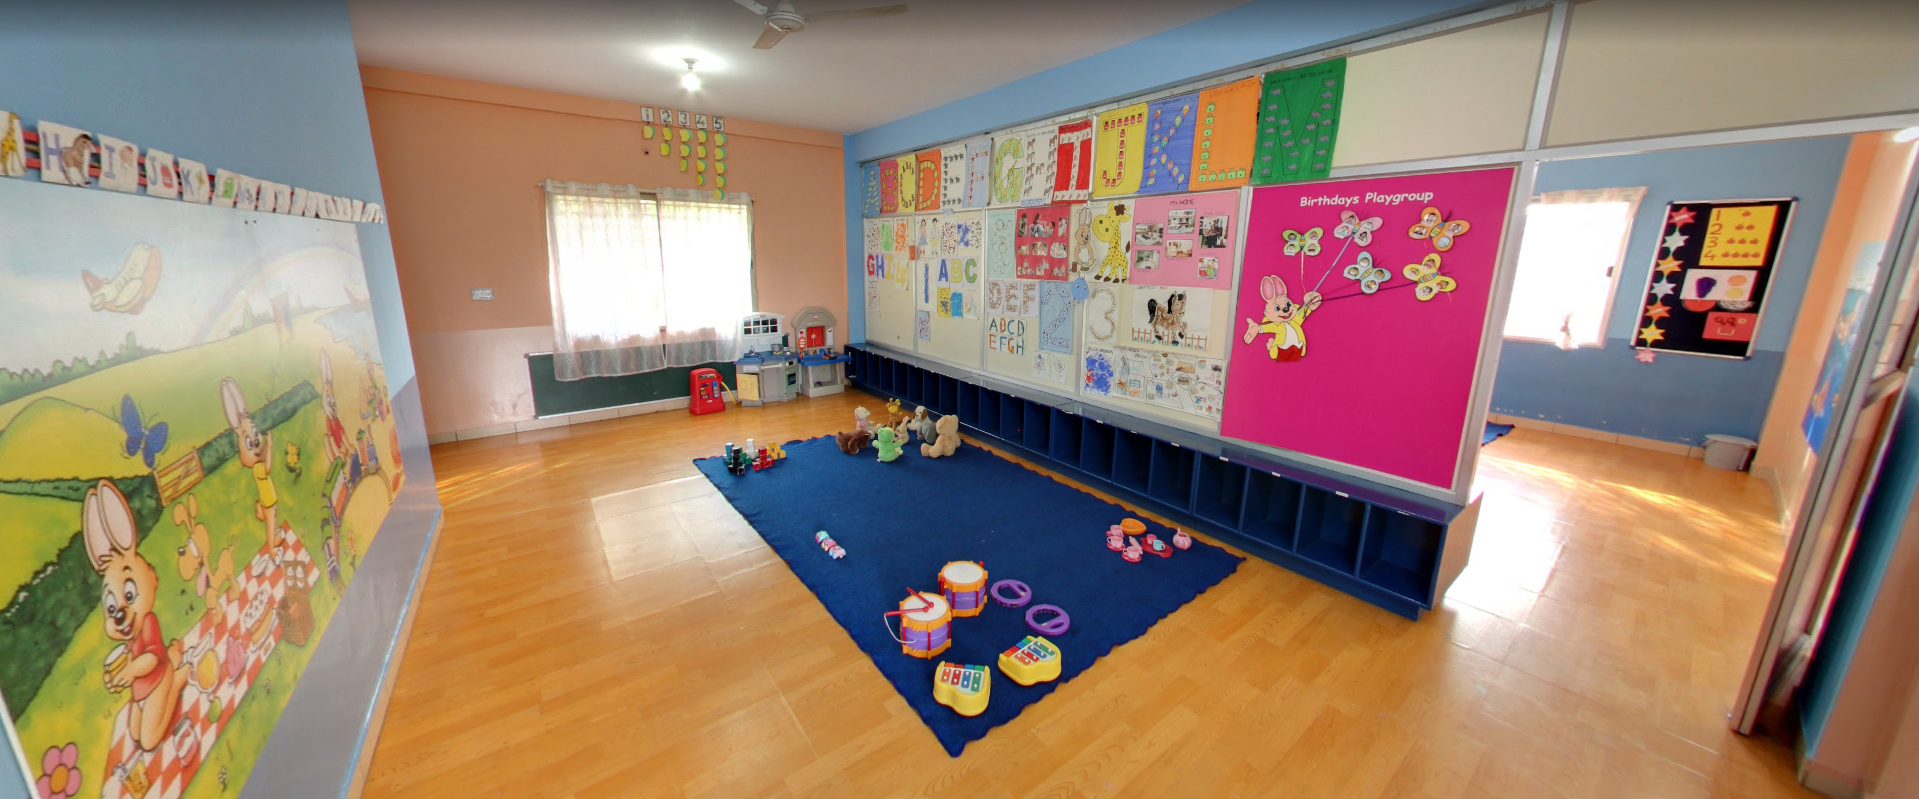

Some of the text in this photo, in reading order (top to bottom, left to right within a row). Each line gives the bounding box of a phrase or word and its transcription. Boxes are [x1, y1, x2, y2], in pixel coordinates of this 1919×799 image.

[42, 131, 64, 173] H
[104, 144, 116, 180] I
[181, 167, 195, 196] K
[918, 160, 938, 210] D
[994, 138, 1024, 203] G
[1300, 191, 1434, 207] Birthdays Playgroup
[1713, 209, 1722, 221] 1
[1706, 237, 1718, 248] 3
[1710, 223, 1723, 235] 2
[1703, 250, 1716, 261] 4
[1041, 285, 1071, 348] 2
[1090, 287, 1117, 341] 3
